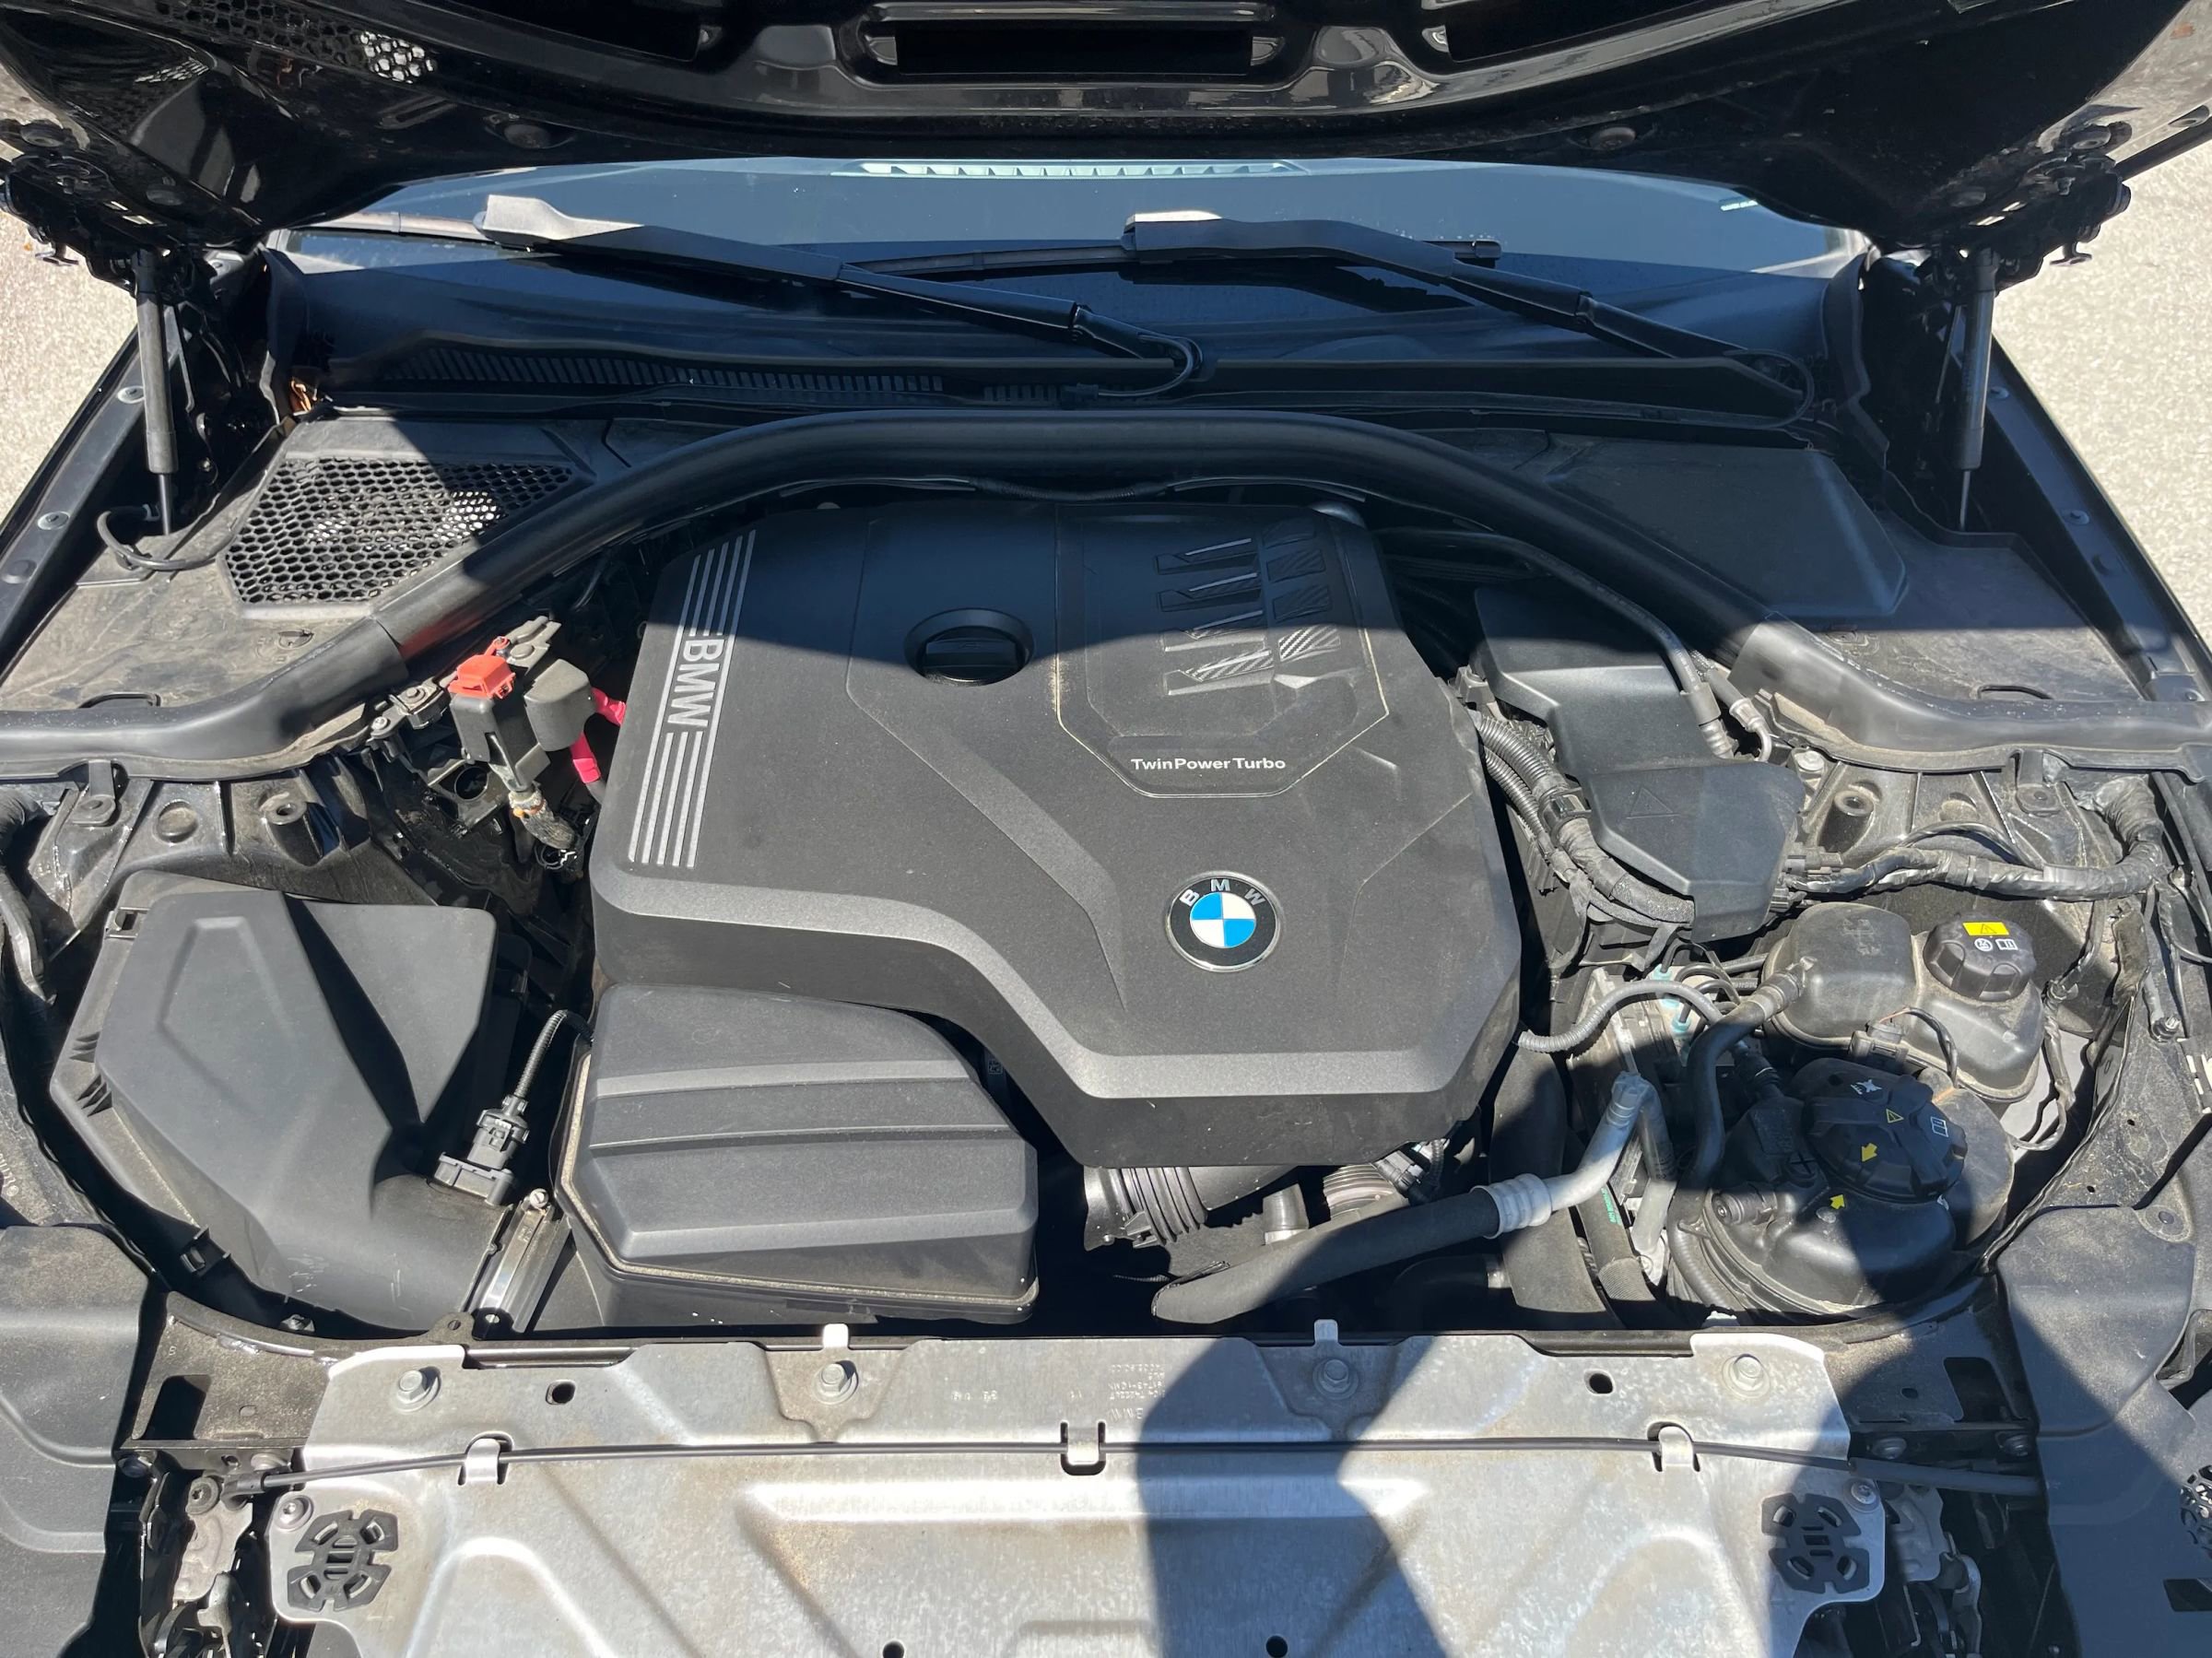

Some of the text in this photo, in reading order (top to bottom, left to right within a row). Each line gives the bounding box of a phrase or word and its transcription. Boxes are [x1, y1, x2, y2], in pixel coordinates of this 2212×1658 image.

[667, 639, 725, 727] BMW
[1231, 757, 1287, 770] Turbo
[1179, 878, 1266, 907] BMW
